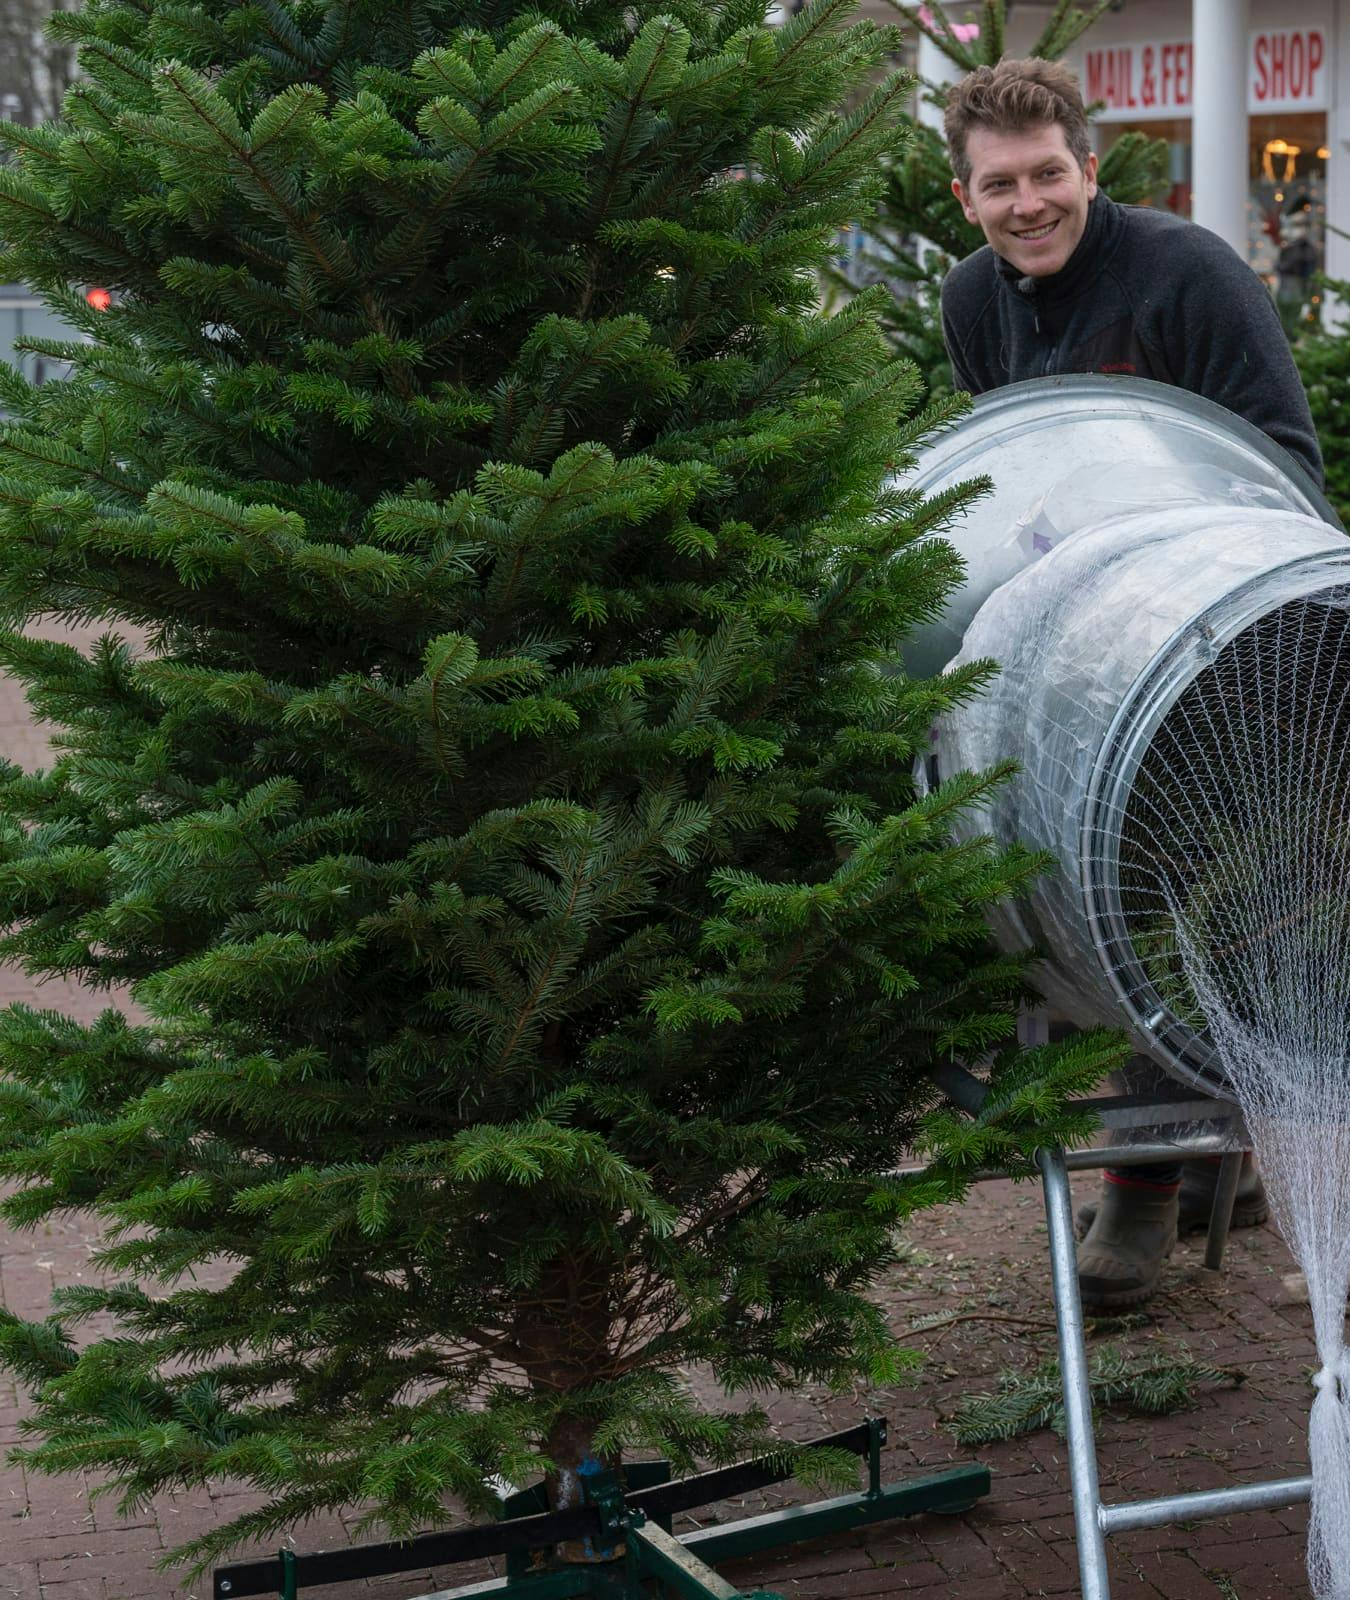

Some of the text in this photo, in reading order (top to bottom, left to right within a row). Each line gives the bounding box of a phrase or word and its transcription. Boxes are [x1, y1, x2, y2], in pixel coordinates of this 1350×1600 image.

[1086, 48, 1136, 108] MAIL
[1142, 46, 1155, 107] &
[1254, 31, 1324, 101] SHOP
